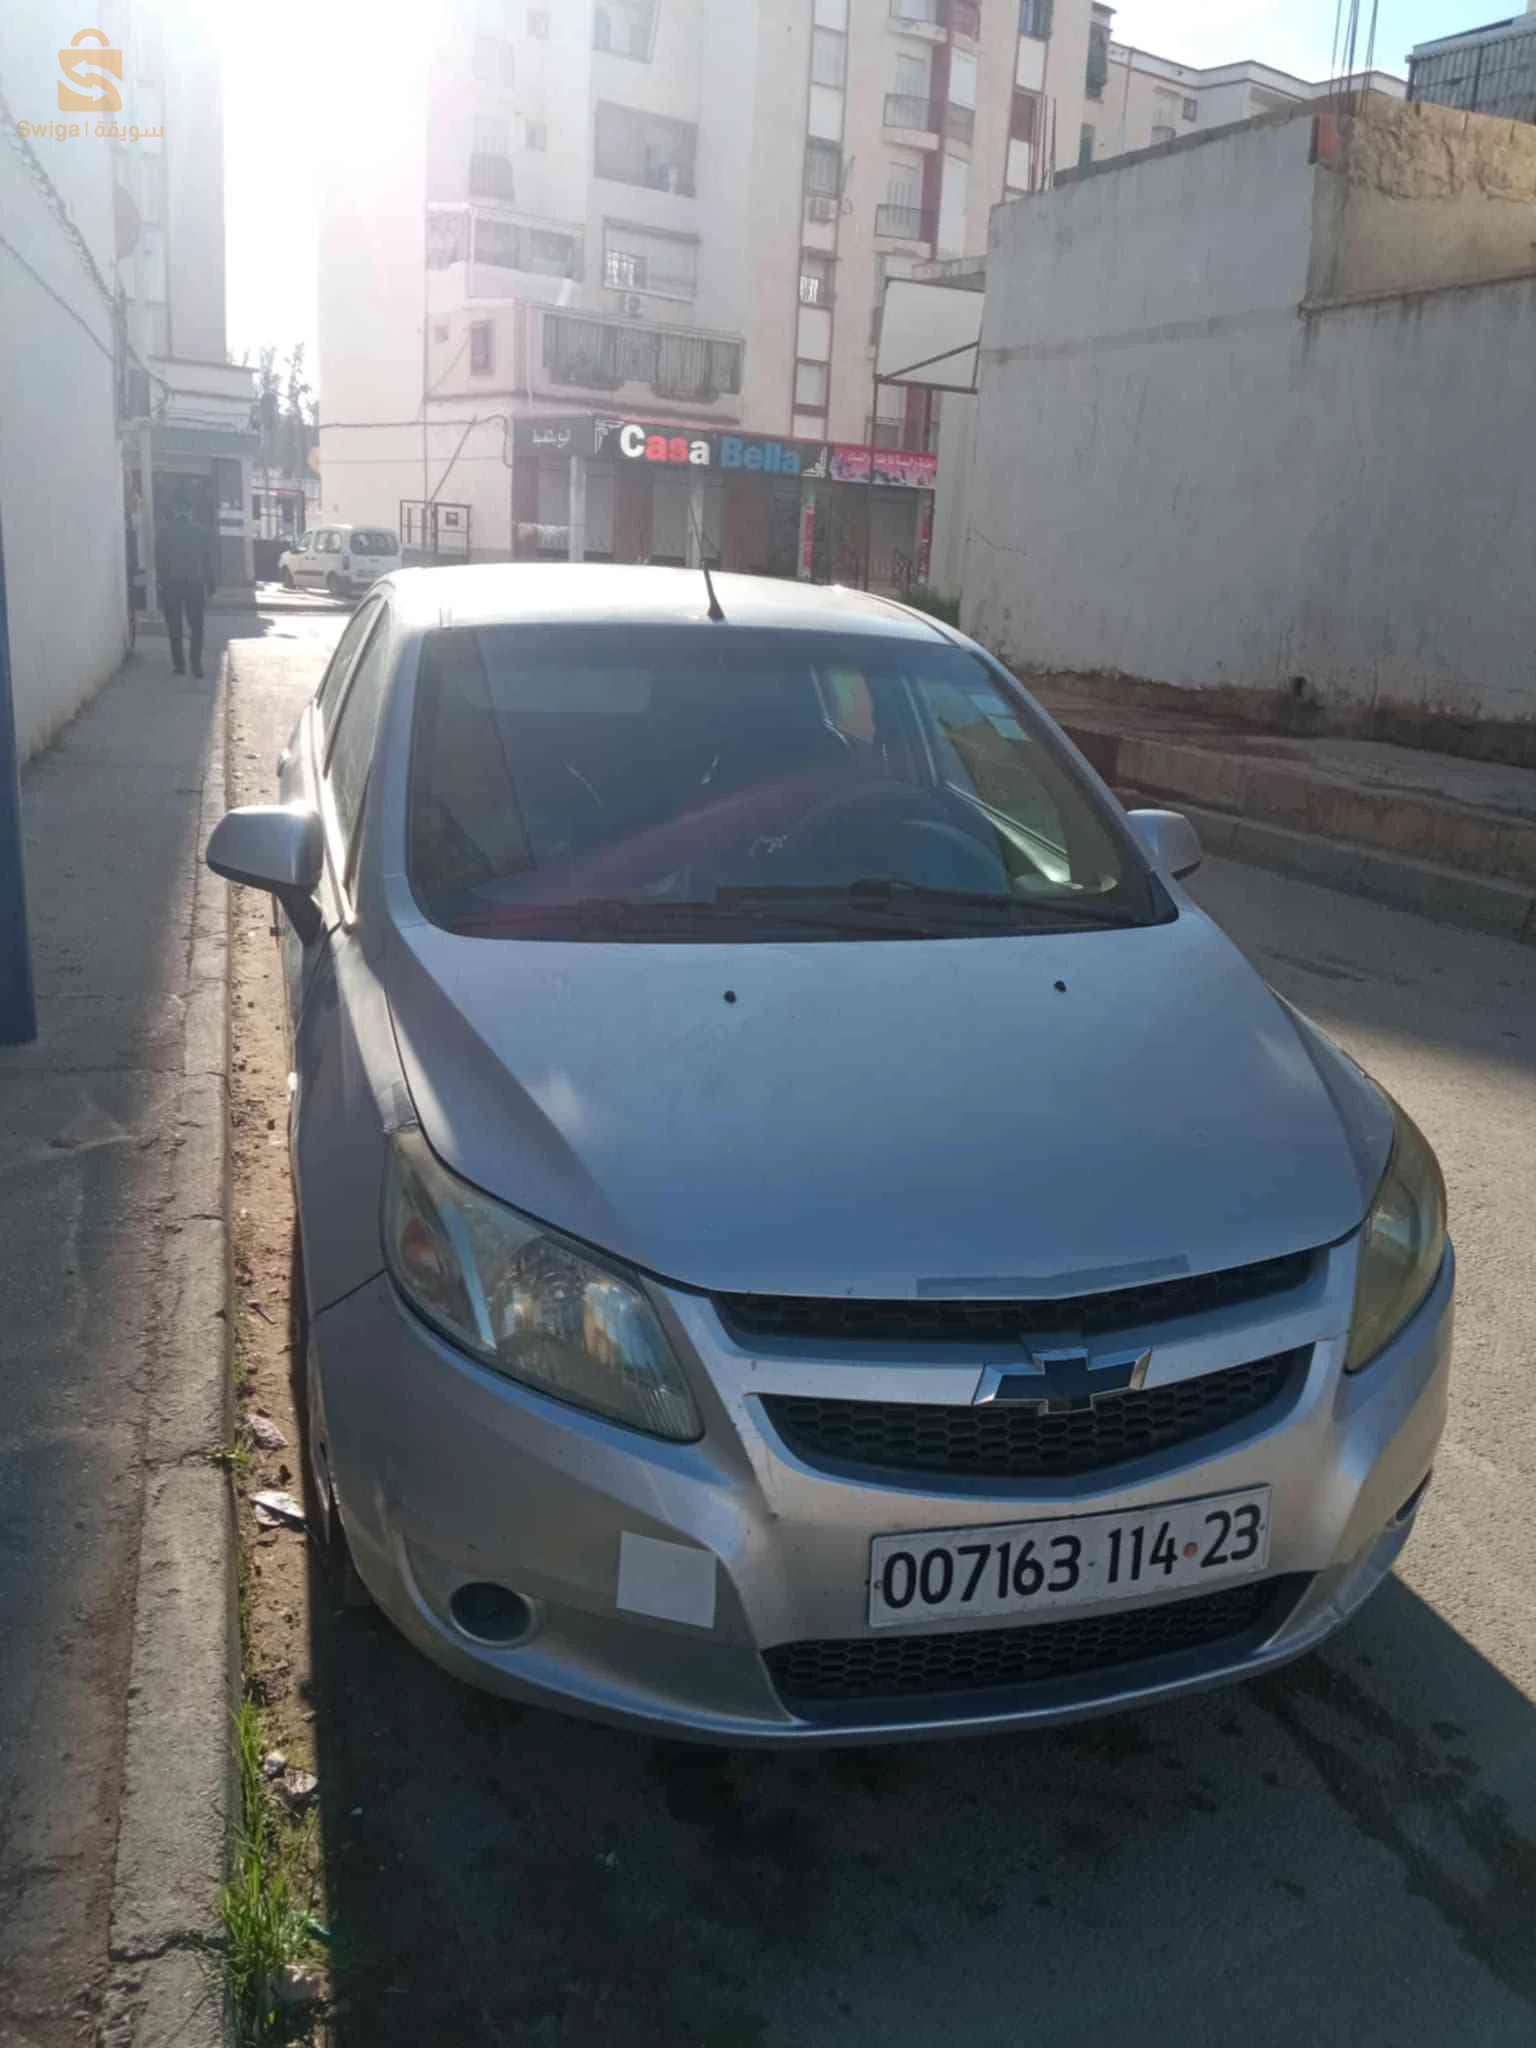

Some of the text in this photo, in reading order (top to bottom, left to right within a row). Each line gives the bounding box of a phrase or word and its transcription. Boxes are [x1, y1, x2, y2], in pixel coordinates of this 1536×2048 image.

[620, 424, 710, 465] Casa
[720, 436, 801, 475] Bella
[882, 1503, 1262, 1609] 007163 114 23
